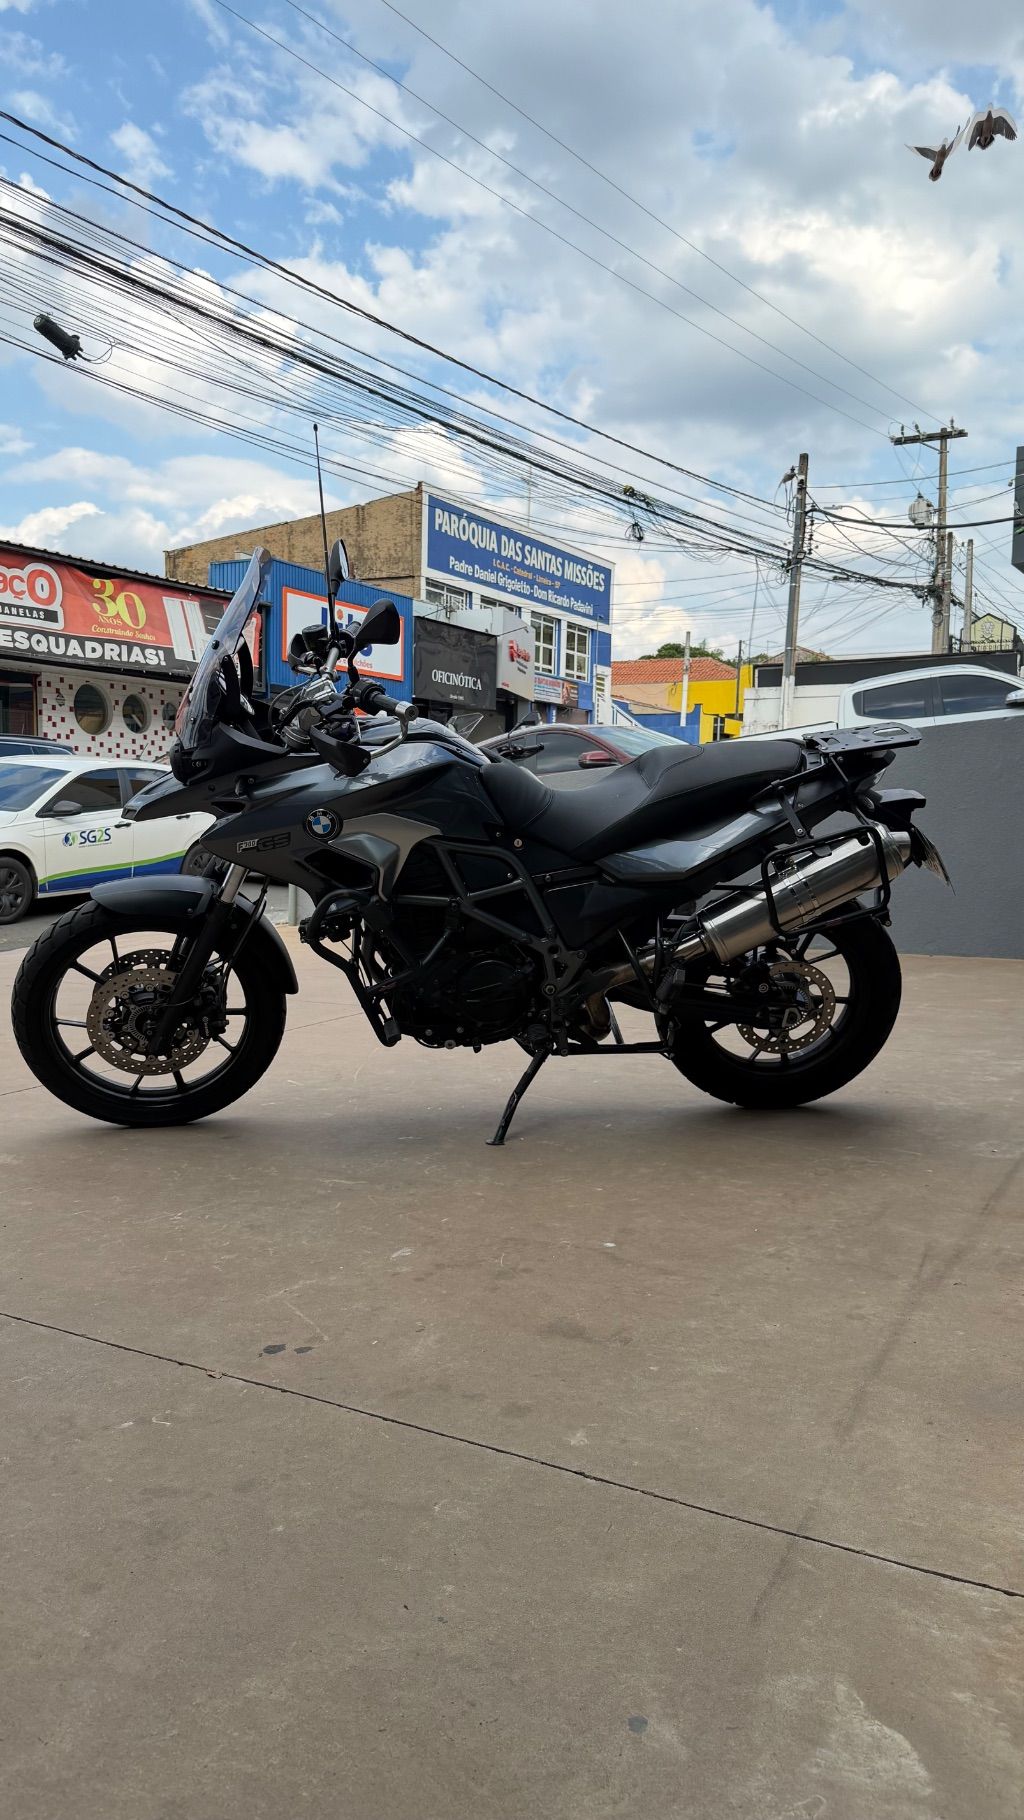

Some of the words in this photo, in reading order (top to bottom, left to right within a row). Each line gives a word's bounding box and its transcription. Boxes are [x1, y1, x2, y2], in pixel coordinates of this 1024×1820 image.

[435, 508, 498, 553] PARÓQUIA
[501, 535, 522, 562] DAS
[524, 544, 562, 577] SANTAS
[564, 560, 605, 592] MISSÕES
[449, 555, 473, 575] Padre
[474, 565, 497, 583] Daniel
[534, 585, 548, 601] Dom
[92, 579, 146, 629] 30
[0, 628, 166, 666] ESQUADRIAS!
[431, 669, 482, 690] OFICINÓTICA
[79, 827, 111, 845] SG2S
